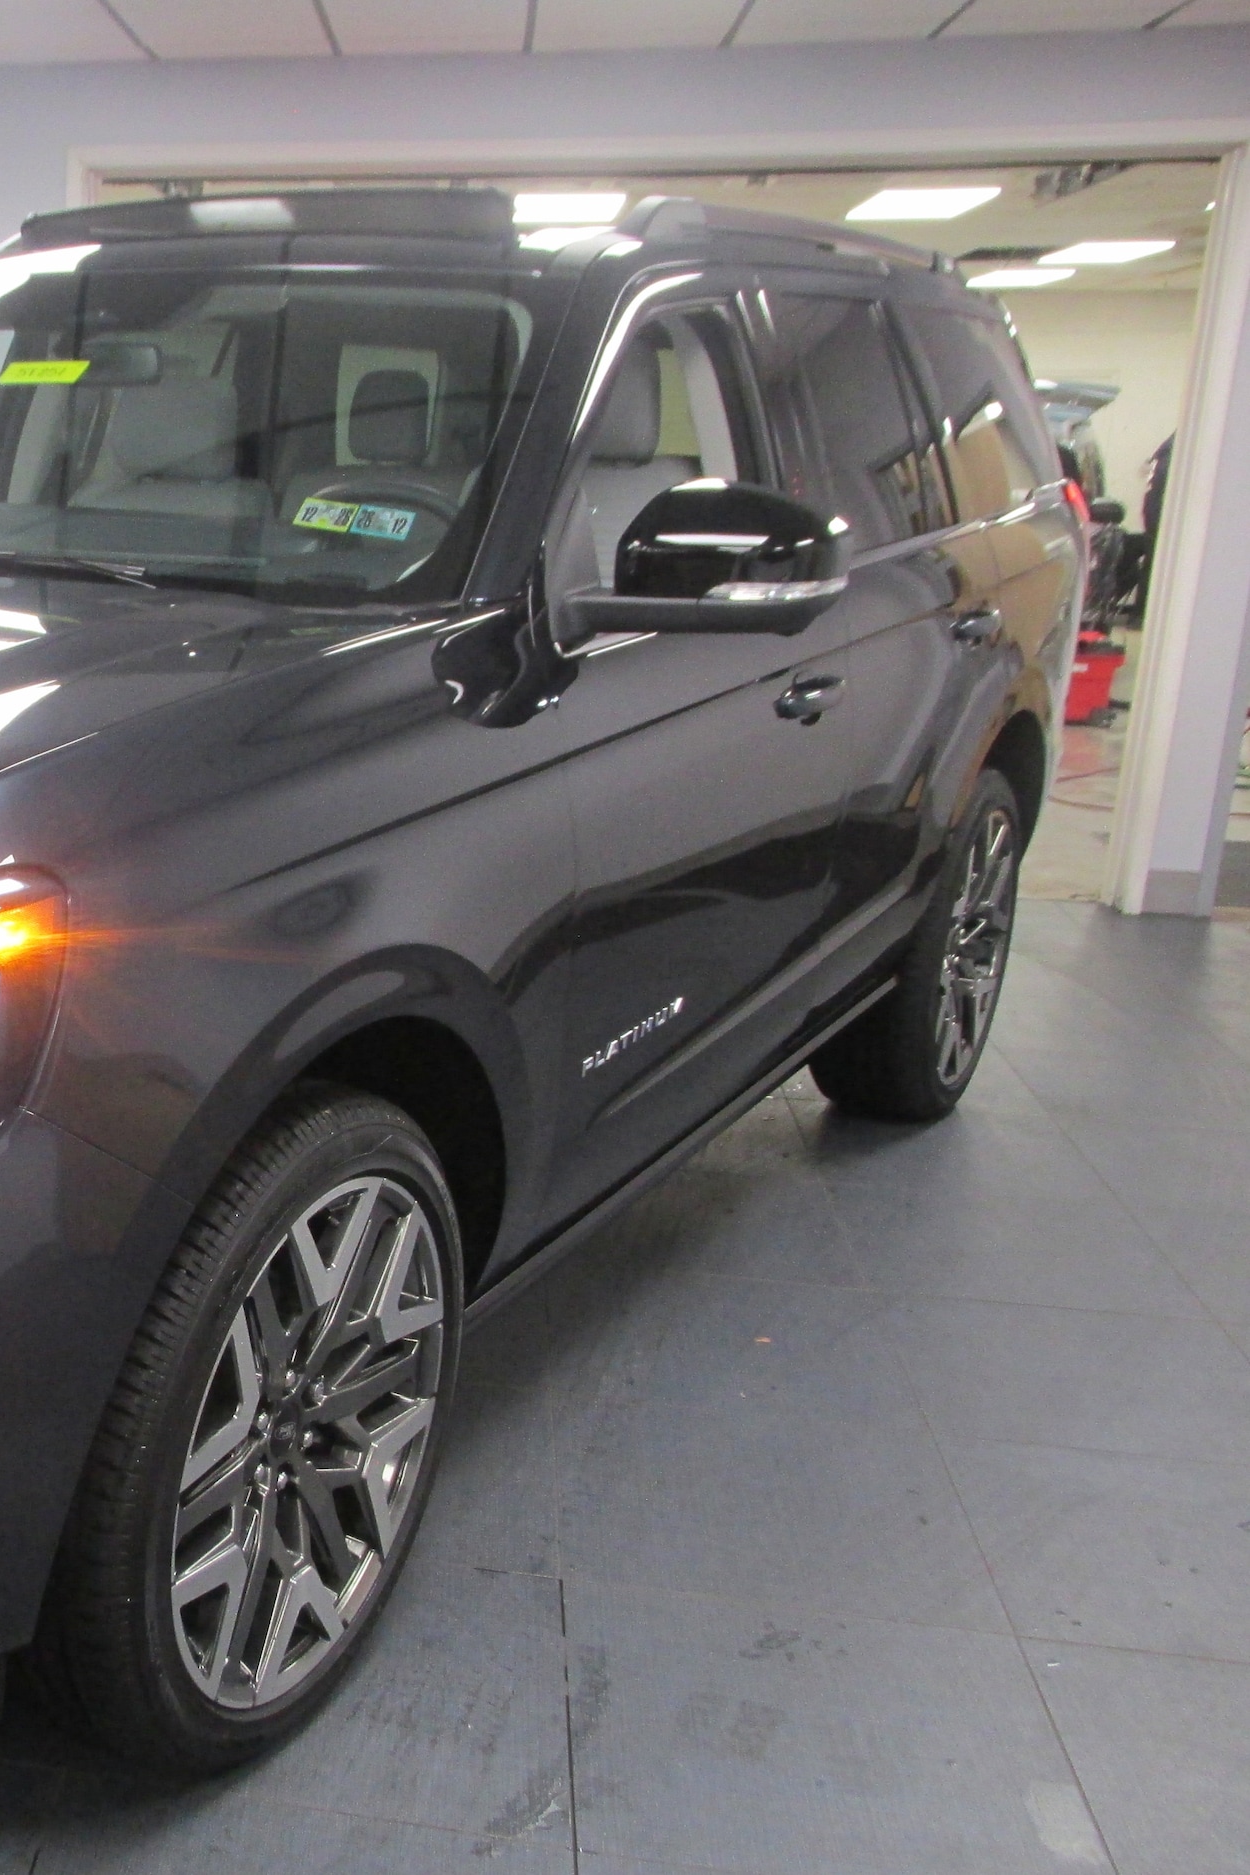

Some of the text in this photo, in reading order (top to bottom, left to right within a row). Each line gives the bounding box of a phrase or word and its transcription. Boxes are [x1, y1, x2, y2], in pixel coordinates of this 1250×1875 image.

[300, 506, 318, 523] 12
[391, 517, 408, 535] 12
[581, 996, 684, 1078] PLATINUM
